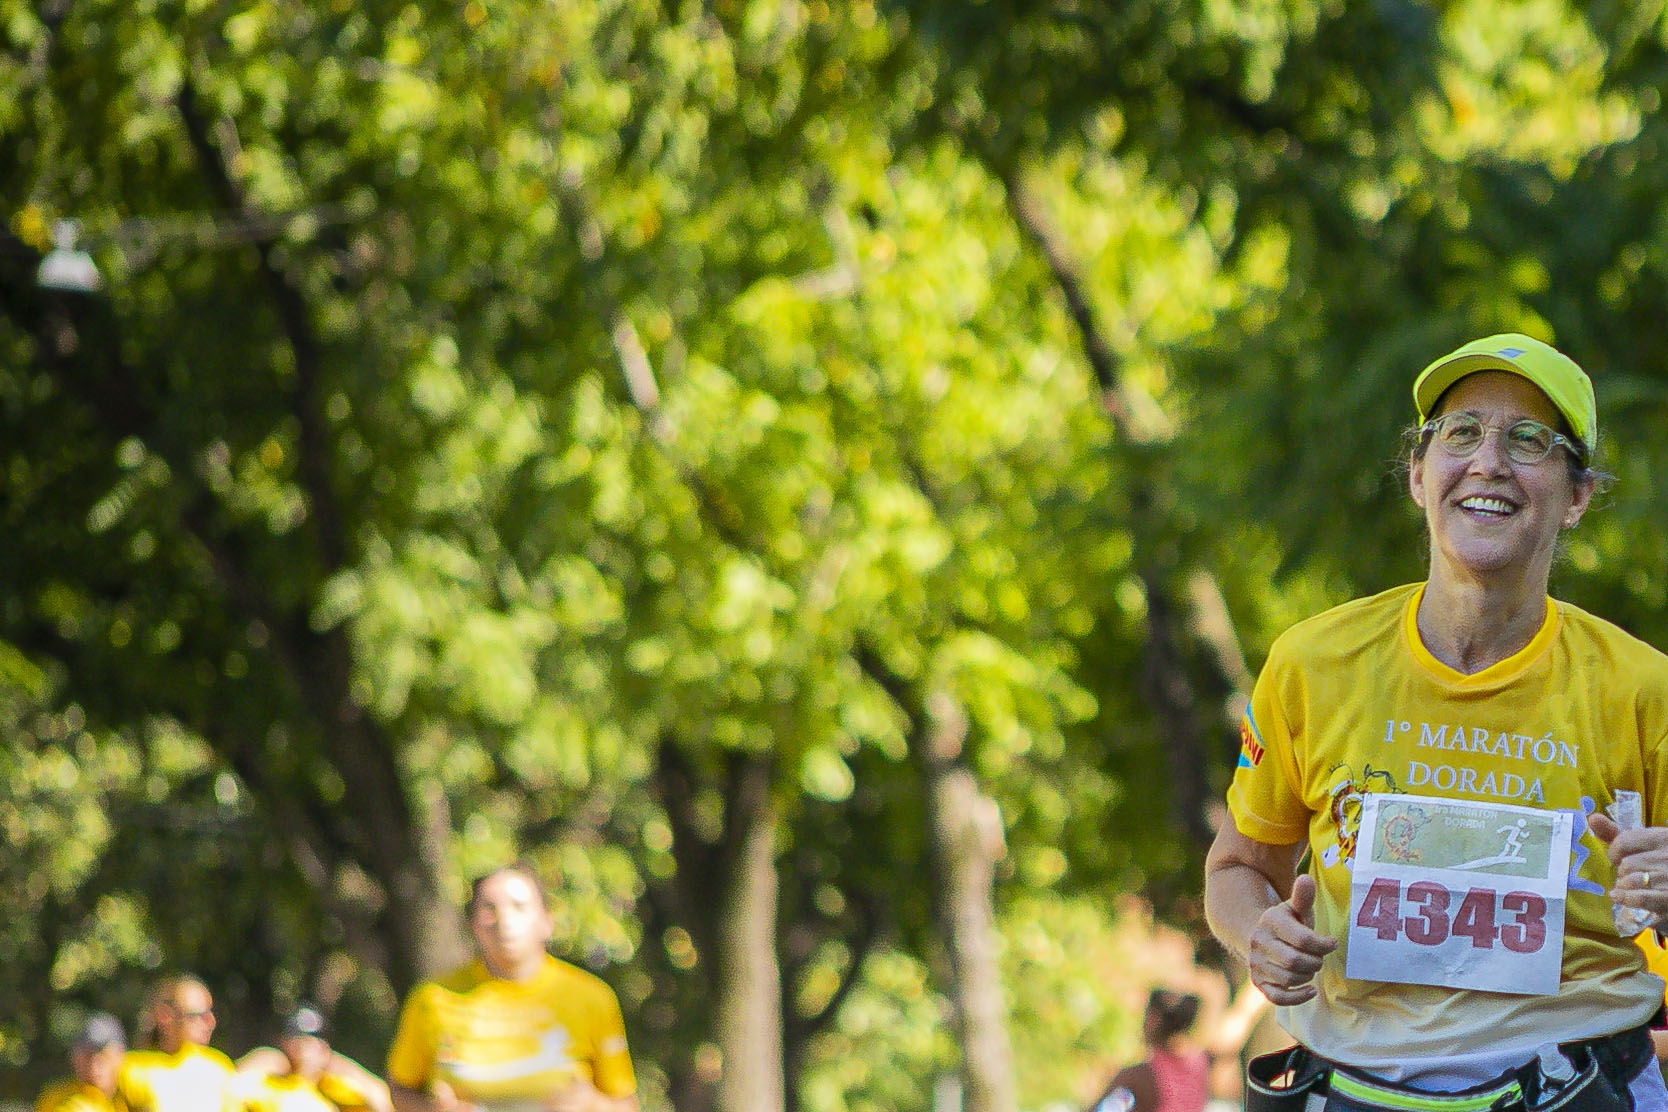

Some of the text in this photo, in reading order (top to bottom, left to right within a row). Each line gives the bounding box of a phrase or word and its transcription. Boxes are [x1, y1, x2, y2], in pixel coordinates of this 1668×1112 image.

[1384, 719, 1580, 769] 1° MARATÓN
[1406, 760, 1545, 804] DORADA
[1357, 877, 1547, 954] 4343
